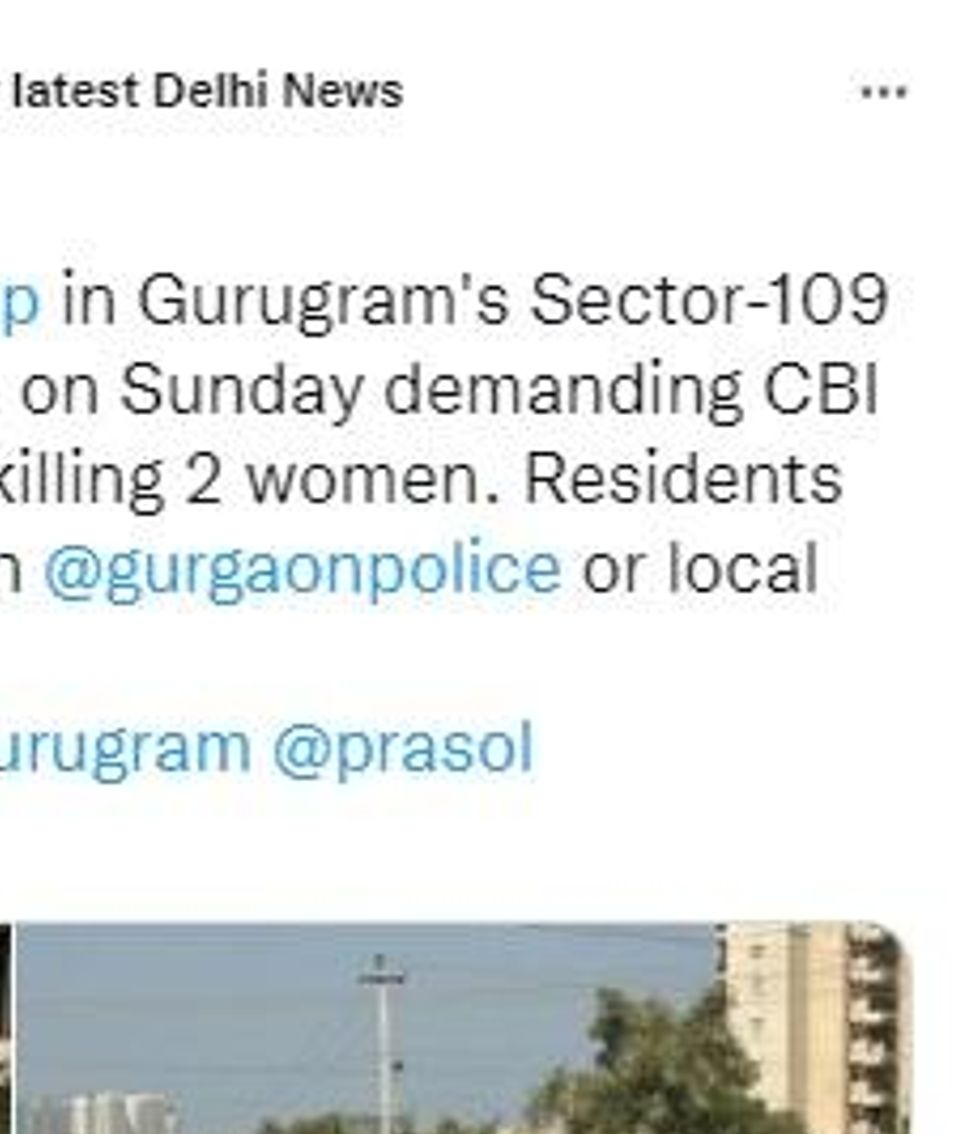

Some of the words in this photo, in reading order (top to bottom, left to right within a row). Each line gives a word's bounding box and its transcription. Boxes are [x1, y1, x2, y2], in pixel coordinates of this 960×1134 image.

[14, 72, 139, 108] latest
[155, 69, 266, 108] Delhi
[284, 72, 403, 108] News
[64, 268, 115, 324] in
[139, 272, 509, 338] Gurugram's
[531, 272, 888, 326] Sector-109
[22, 374, 98, 415] on
[122, 362, 366, 428] Sunday
[385, 358, 744, 428] demanding
[764, 362, 877, 415] CBI
[186, 451, 221, 504] 2
[245, 464, 498, 505] women.
[527, 447, 843, 505] Residents
[45, 536, 561, 607] @gurgaonpolice
[584, 553, 647, 594] or
[670, 541, 816, 594] local
[274, 721, 531, 784] @prasol
